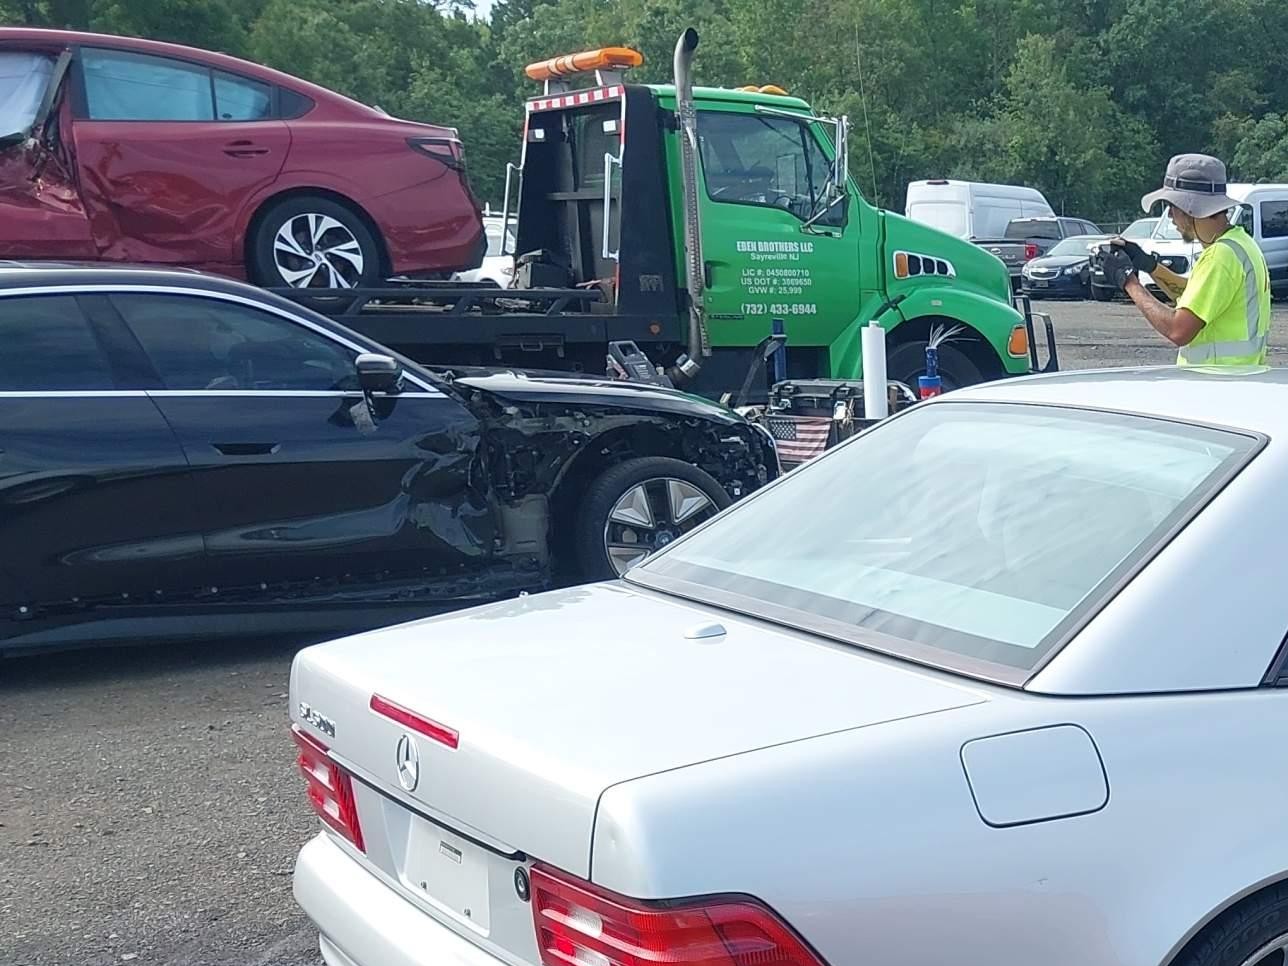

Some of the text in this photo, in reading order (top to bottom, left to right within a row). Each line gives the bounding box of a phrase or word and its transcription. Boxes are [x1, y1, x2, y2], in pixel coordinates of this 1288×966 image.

[758, 240, 799, 253] BROTHERS
[800, 241, 814, 253] LLC
[750, 253, 800, 263] Sayreville NJ
[742, 269, 755, 277] LIC
[748, 286, 768, 294] GVW
[741, 303, 816, 315] (732) 433-6944
